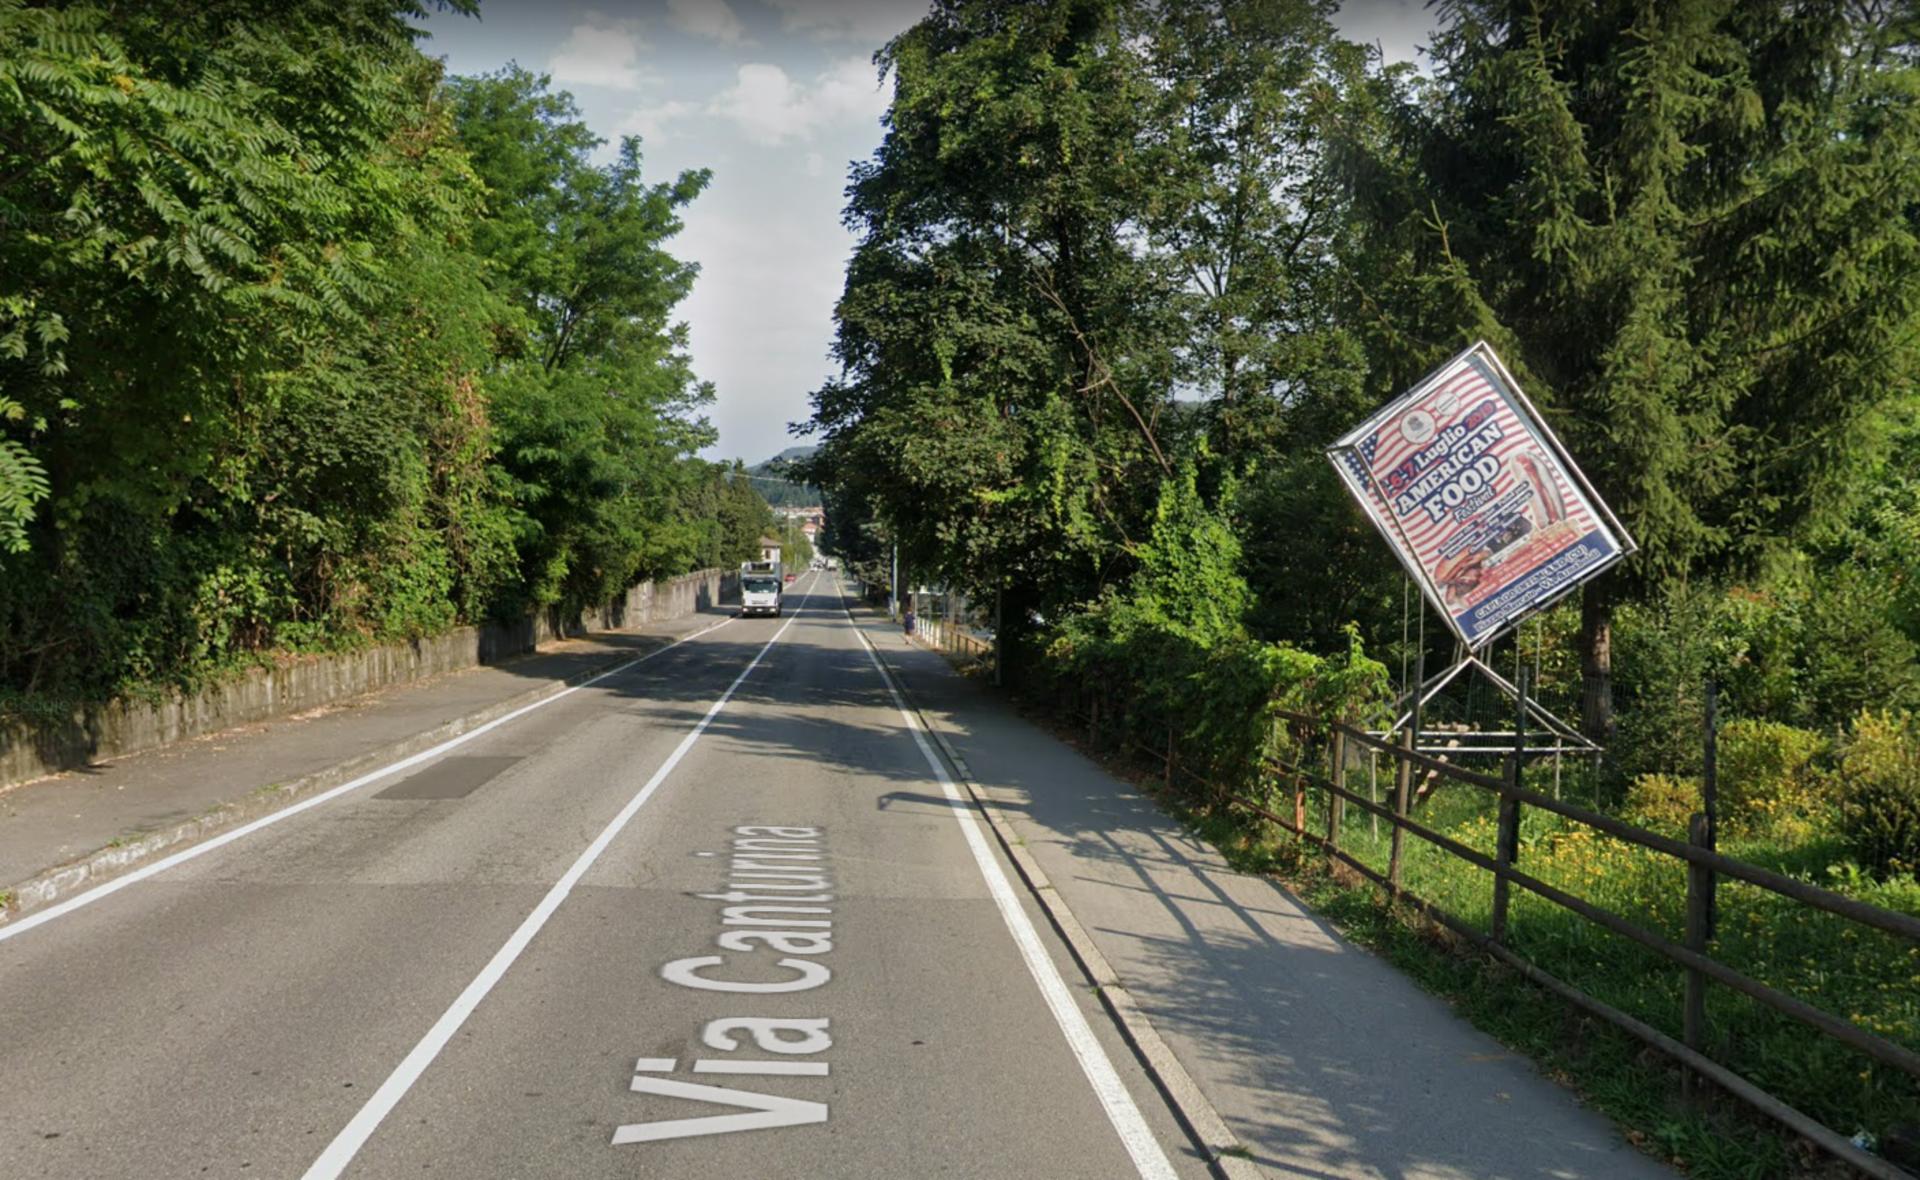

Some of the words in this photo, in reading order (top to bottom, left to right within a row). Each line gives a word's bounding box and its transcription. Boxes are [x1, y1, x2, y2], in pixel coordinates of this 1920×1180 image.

[1398, 422, 1502, 513] AMERICAN
[1414, 428, 1464, 468] Luglio
[1423, 456, 1496, 520] FOOD
[1475, 590, 1515, 619] CAPIAGO
[661, 826, 832, 993] Canturina
[611, 1017, 832, 1145] Via
